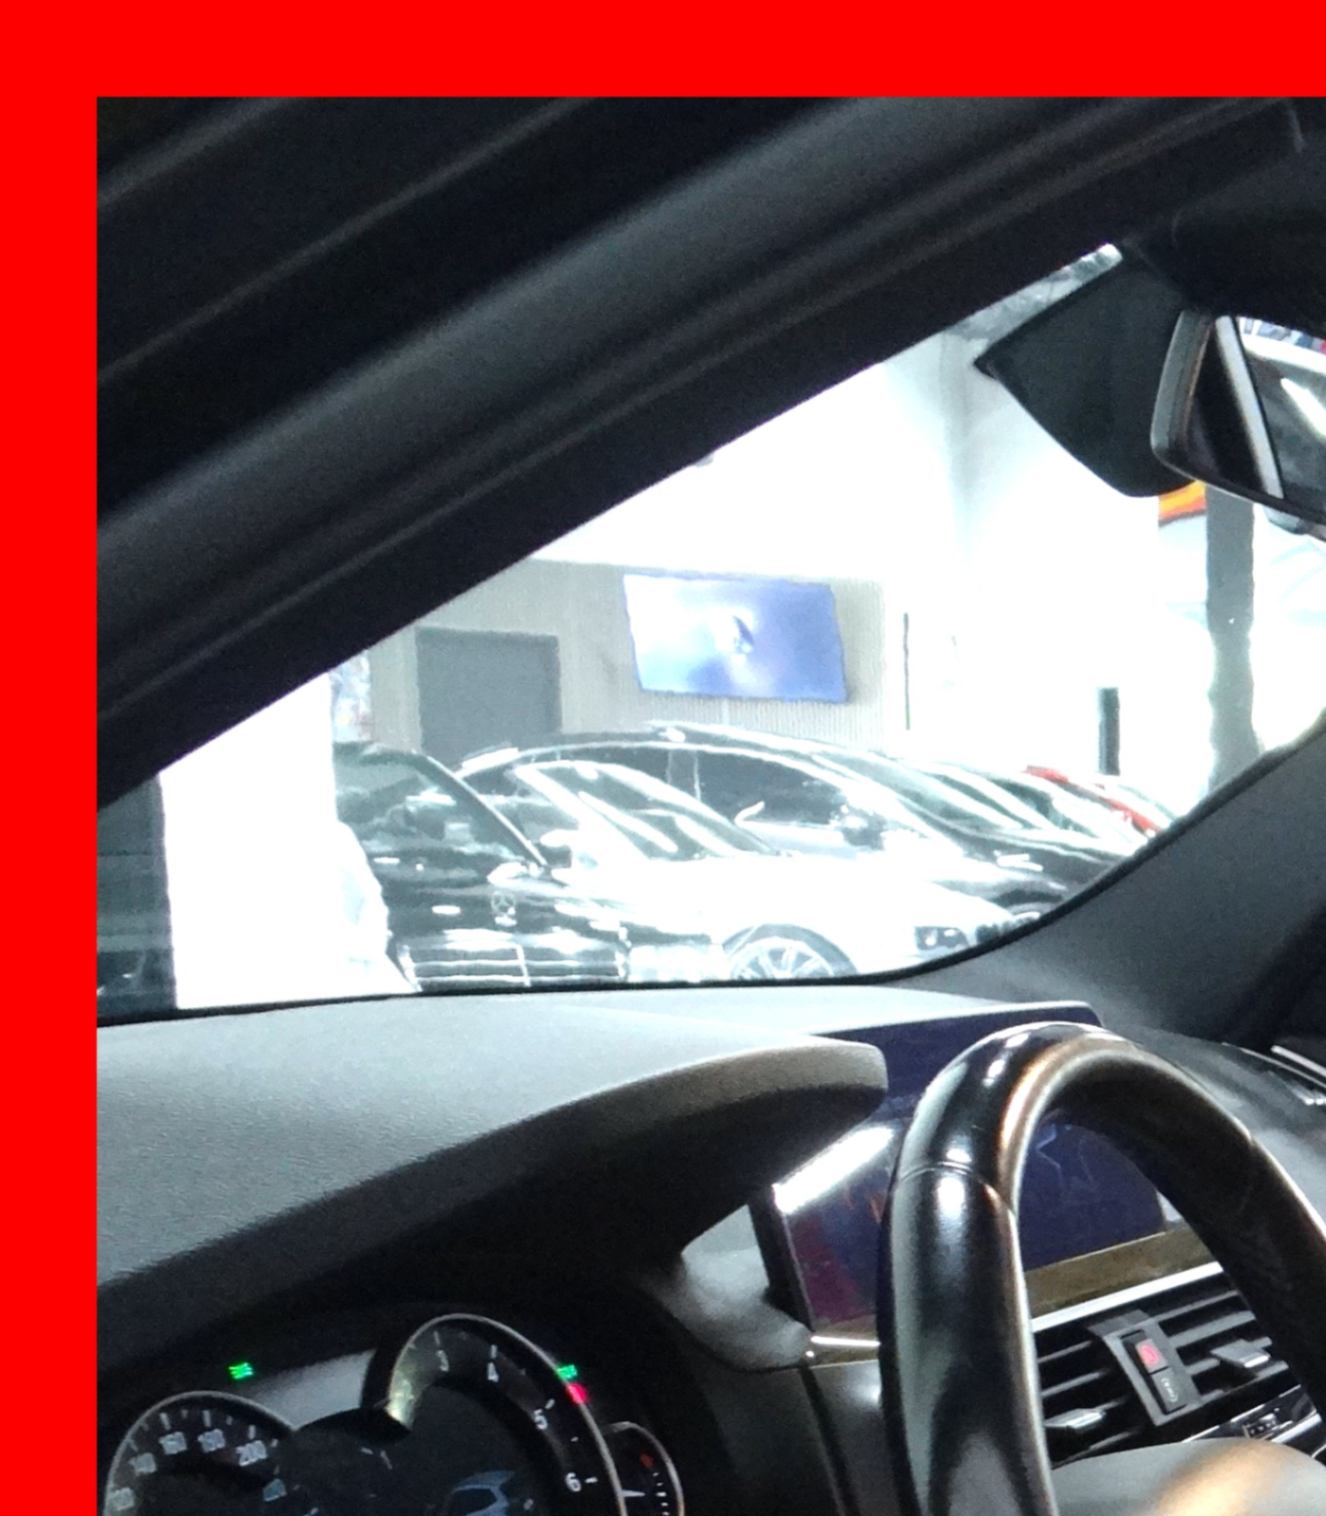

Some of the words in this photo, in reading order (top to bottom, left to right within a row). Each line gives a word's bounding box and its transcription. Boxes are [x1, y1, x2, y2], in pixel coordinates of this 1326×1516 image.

[487, 1362, 499, 1382] 4
[533, 1409, 549, 1430] 5
[565, 1472, 582, 1492] 6
